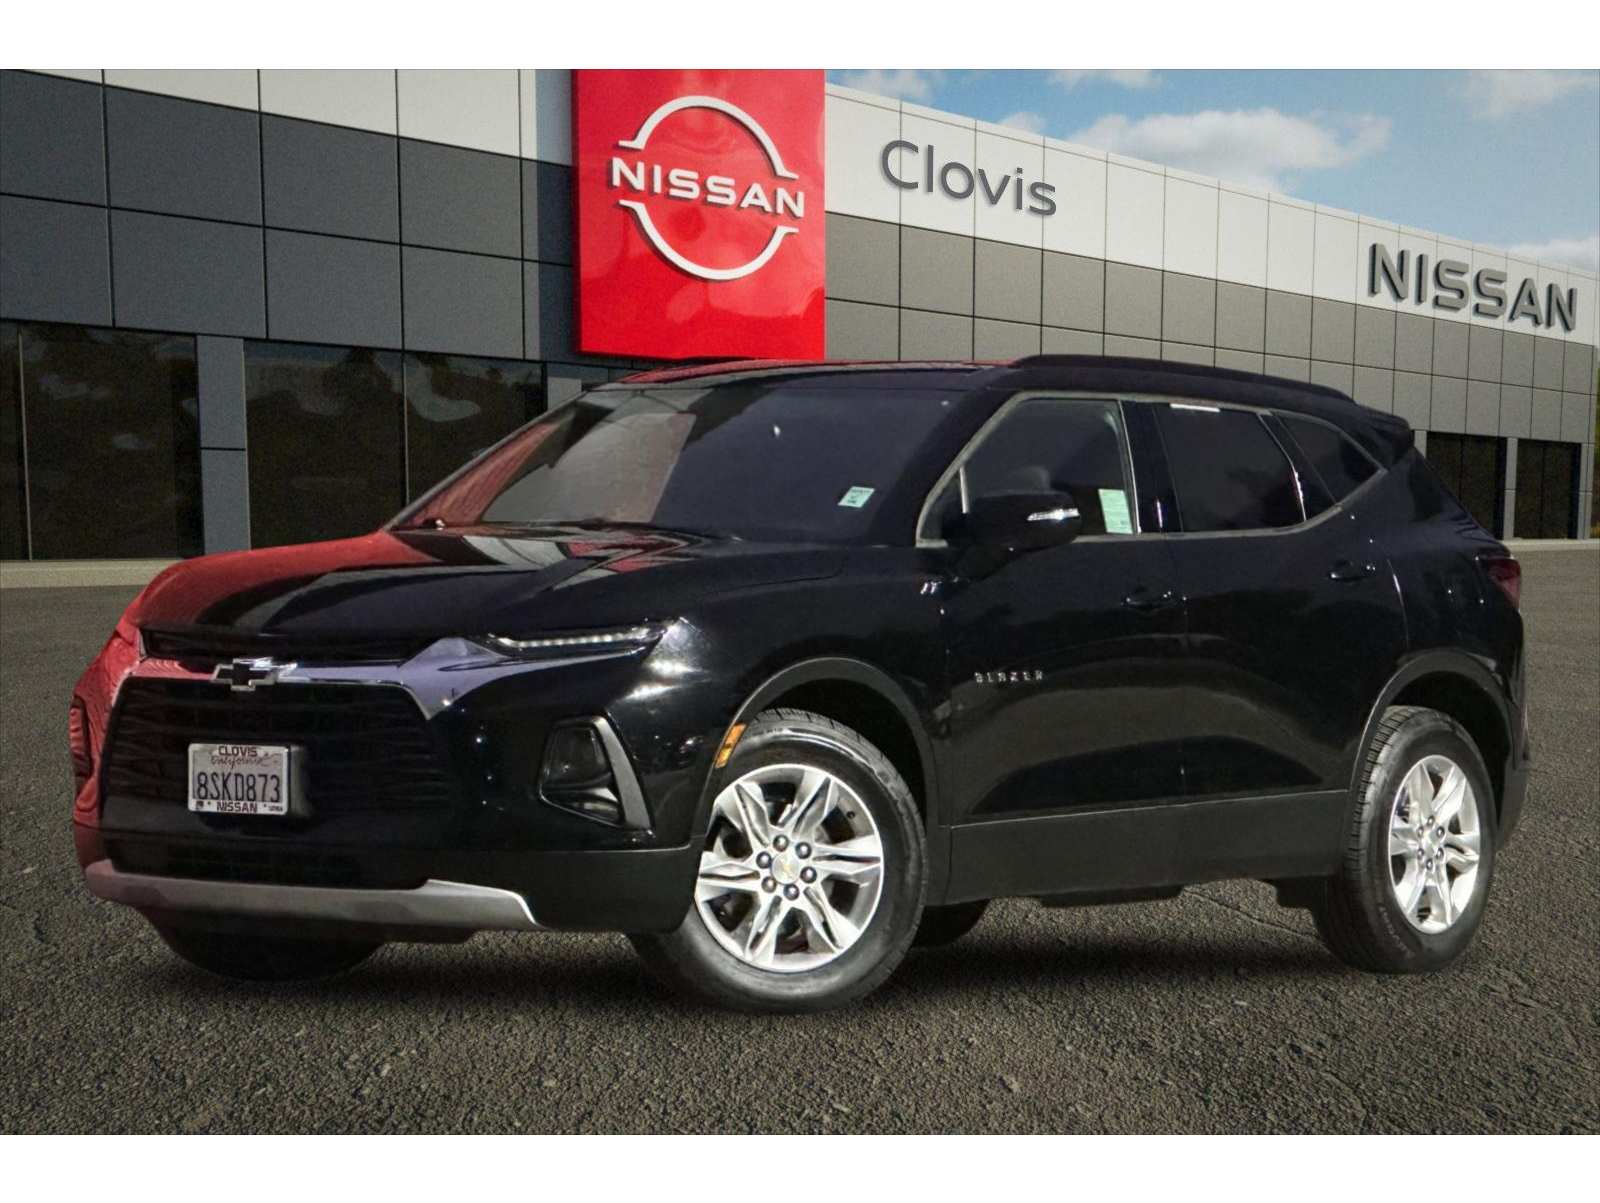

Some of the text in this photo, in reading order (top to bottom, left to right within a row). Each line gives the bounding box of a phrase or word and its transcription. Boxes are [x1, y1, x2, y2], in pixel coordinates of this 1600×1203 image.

[610, 157, 805, 218] NISSAN
[881, 139, 1057, 216] Clovis
[1368, 243, 1578, 331] NISSAN
[218, 746, 258, 757] CLOVIS
[197, 772, 280, 803] 8SKD873
[216, 800, 258, 813] NISSAN
